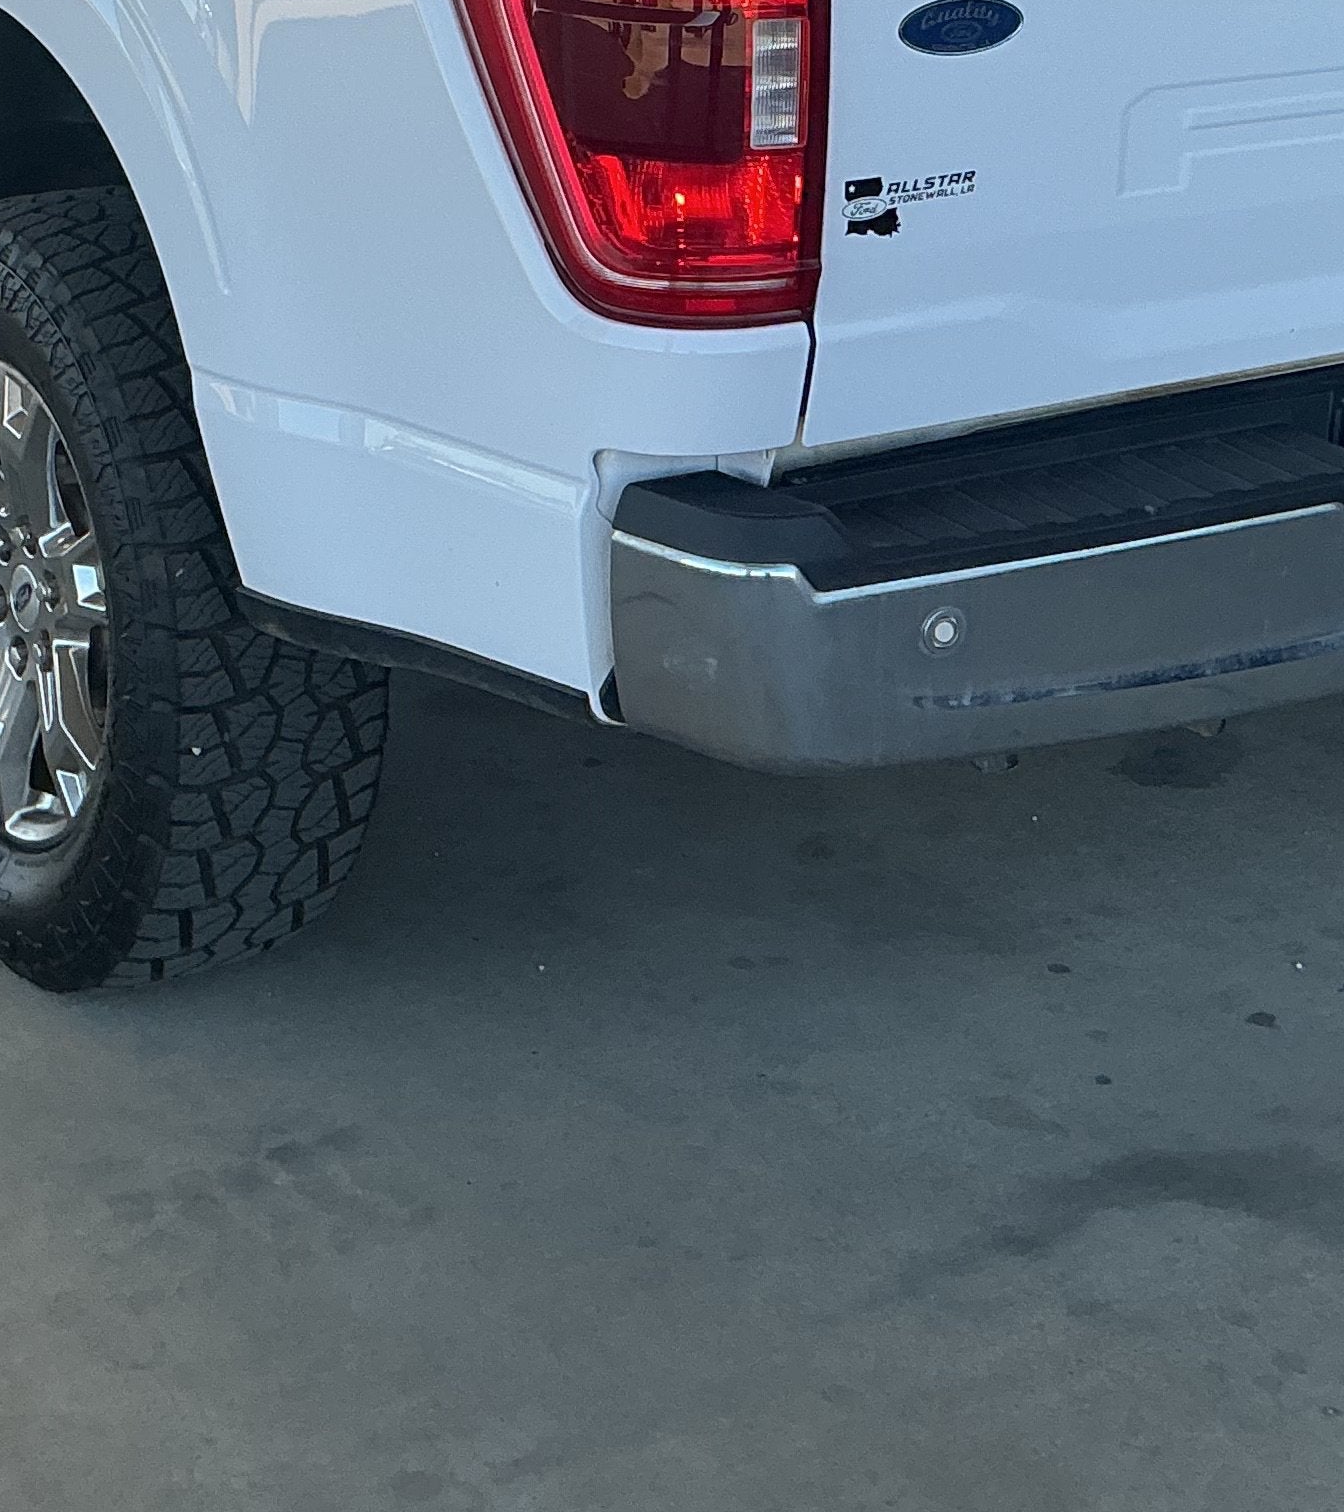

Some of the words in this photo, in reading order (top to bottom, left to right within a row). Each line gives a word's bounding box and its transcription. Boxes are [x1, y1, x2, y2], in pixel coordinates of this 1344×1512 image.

[886, 170, 976, 196] ALLSTAR
[960, 183, 976, 195] LA
[850, 201, 879, 217] Ford
